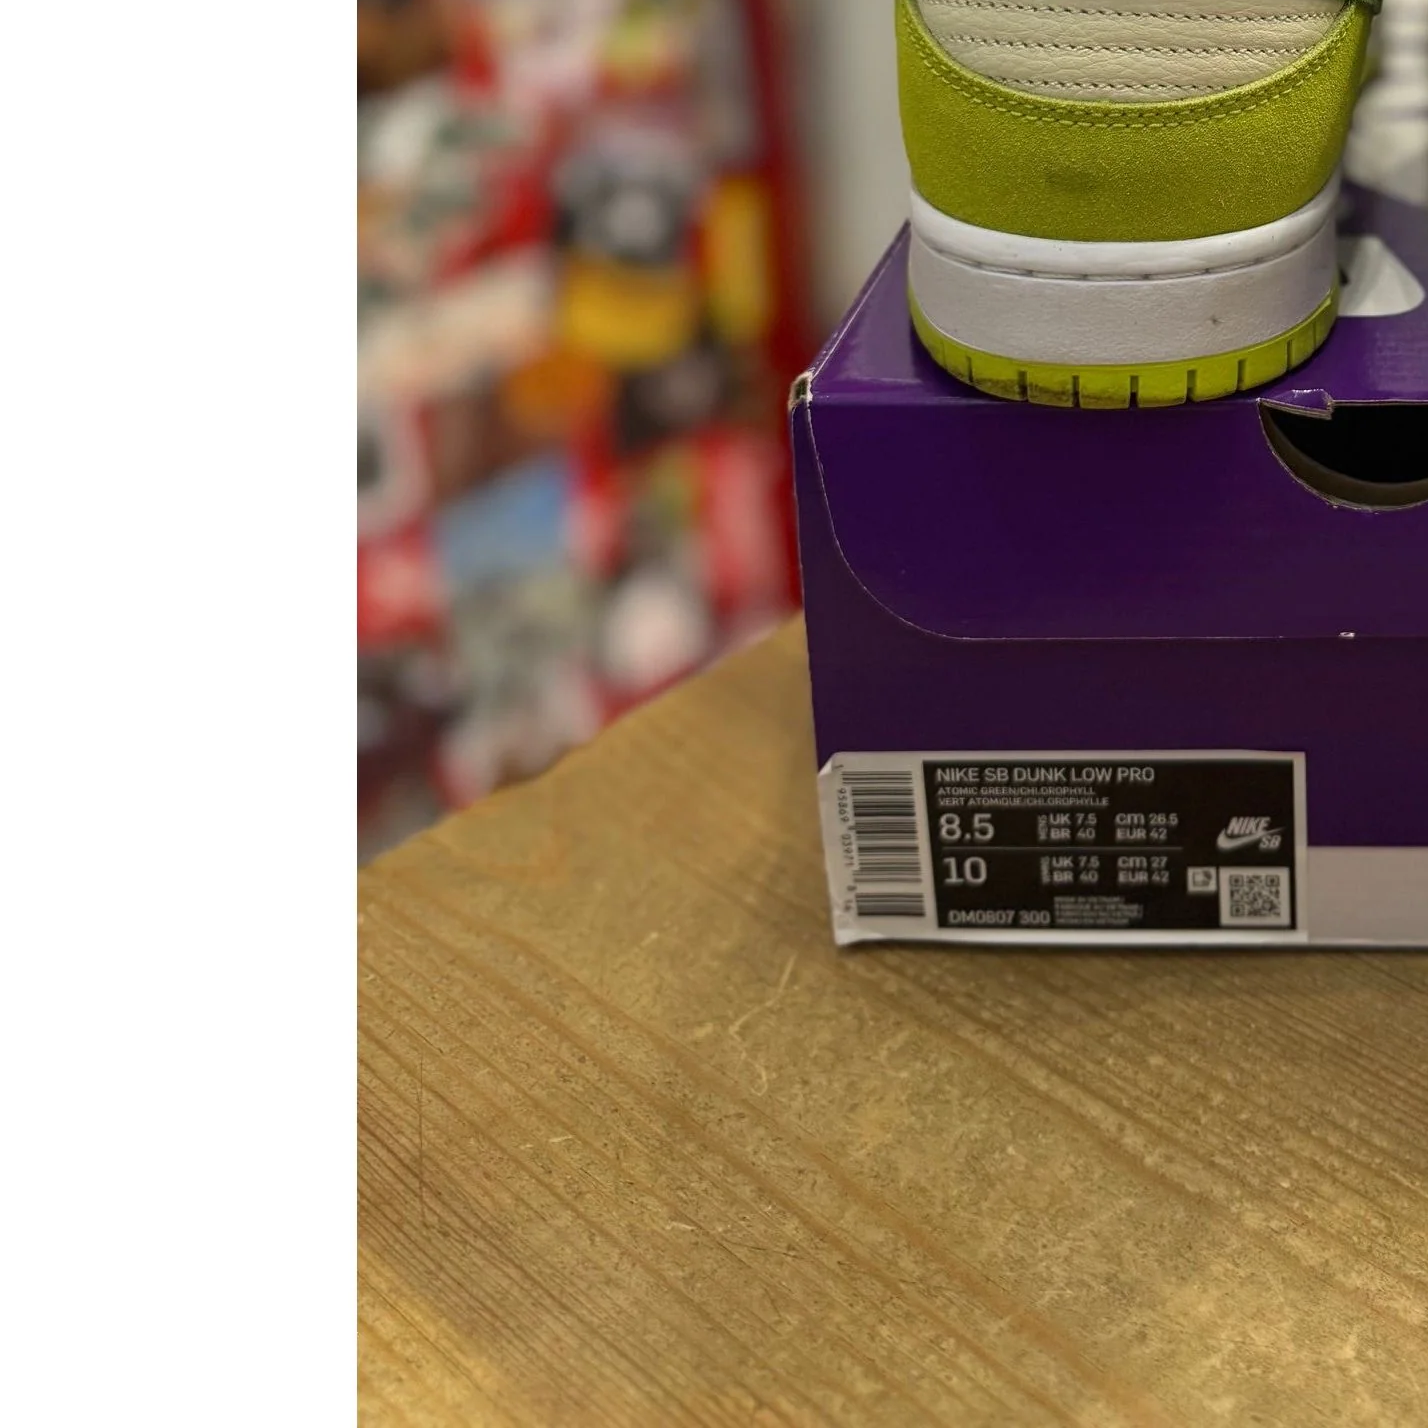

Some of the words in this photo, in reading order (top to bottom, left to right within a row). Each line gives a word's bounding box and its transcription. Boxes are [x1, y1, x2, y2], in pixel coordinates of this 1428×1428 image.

[936, 767, 980, 783] NIKE
[984, 767, 1009, 783] SB
[1013, 767, 1067, 783] DUNK
[1071, 767, 1113, 782] LOW
[1117, 767, 1155, 782] PRO
[937, 786, 979, 796] ATOMIC
[980, 786, 1096, 796] GREEN/CHLOROPHYLL
[938, 797, 965, 807] VERT
[967, 796, 1110, 807] ATOMIQUE/CHLOROPHYLLE
[1050, 813, 1072, 825] UK
[1076, 813, 1097, 825] 7.5
[1115, 813, 1145, 825] cm
[1149, 813, 1178, 825] 26.5
[1226, 816, 1271, 835] NIKE
[939, 813, 995, 841] 8.5
[1051, 827, 1072, 840] BR
[1076, 827, 1096, 839] 40
[1115, 827, 1146, 840] EUR
[1149, 827, 1168, 839] 42
[1259, 834, 1282, 848] SB
[1052, 856, 1074, 868] UK
[1078, 856, 1100, 868] 7.5
[1117, 856, 1148, 868] cm
[1151, 856, 1168, 868] 27
[943, 856, 988, 885] 10
[1053, 870, 1074, 883] BR
[1079, 870, 1099, 883] 40
[1117, 870, 1149, 883] EUR
[1151, 870, 1170, 883] 42
[949, 909, 1016, 925] DM0807
[1019, 909, 1051, 924] 300
